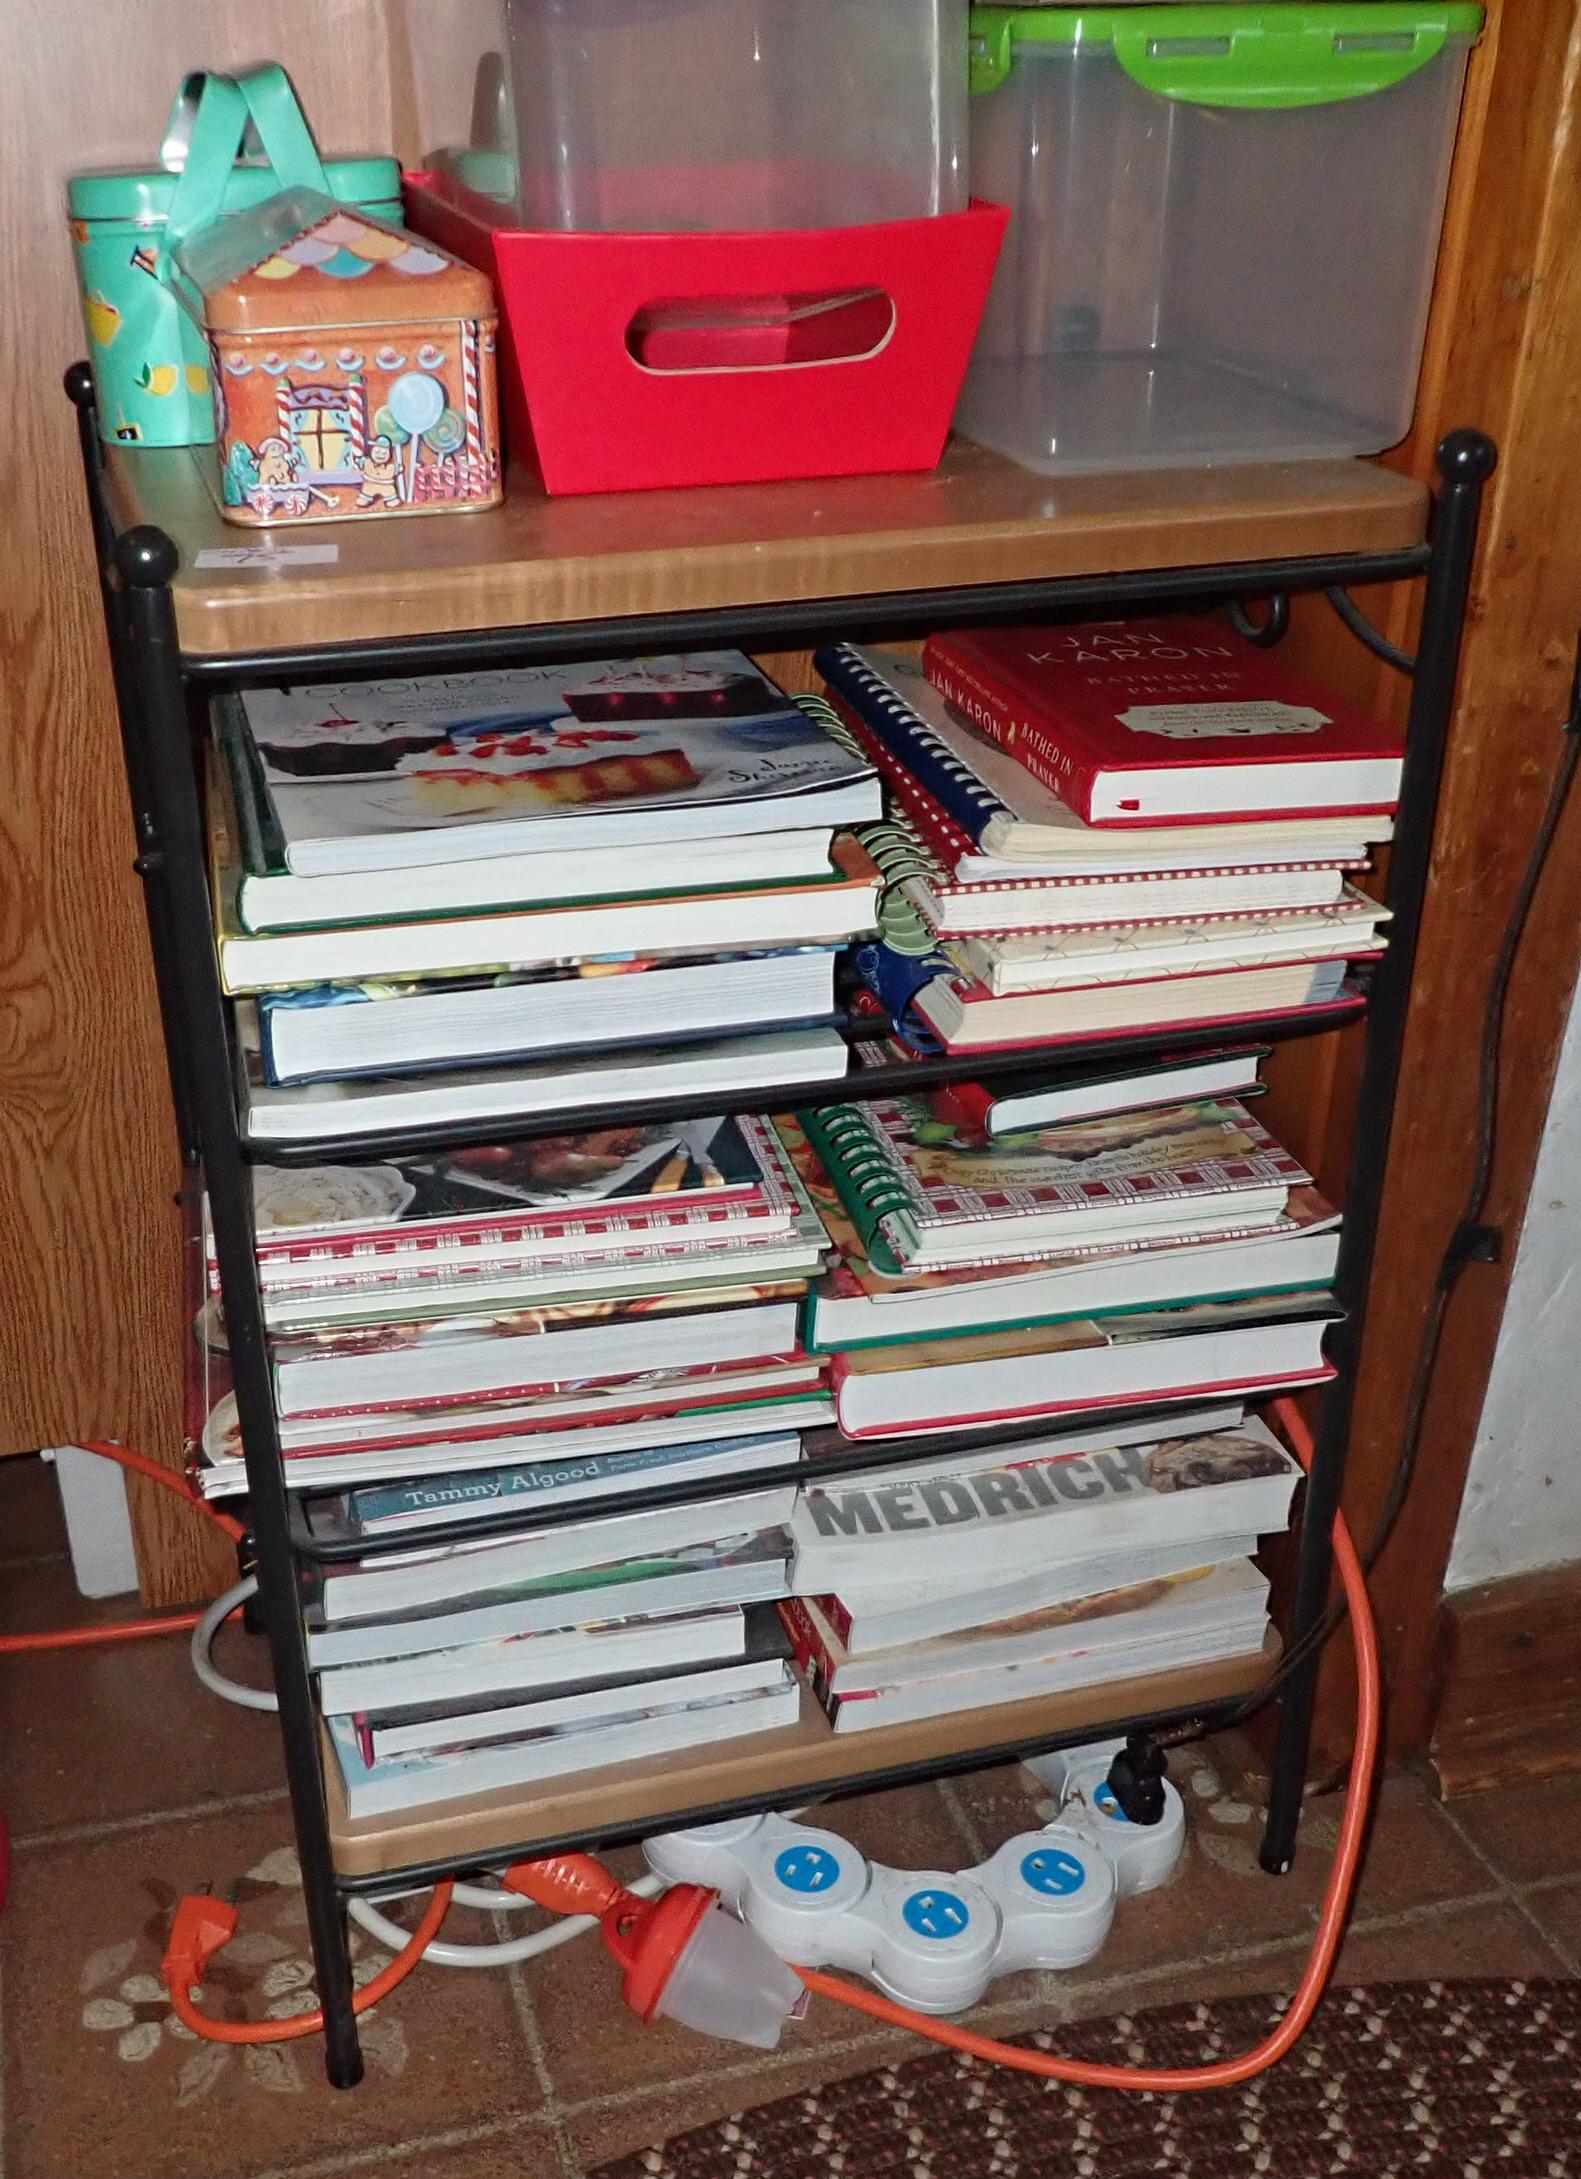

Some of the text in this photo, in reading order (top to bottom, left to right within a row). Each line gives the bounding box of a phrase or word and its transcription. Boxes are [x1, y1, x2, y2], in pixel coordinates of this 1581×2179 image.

[1027, 646, 1233, 664] KARON
[1060, 633, 1164, 647] JAN
[305, 671, 568, 698] COOKBOOK
[930, 669, 953, 699] JAN
[957, 688, 1001, 743] KARON
[1021, 722, 1074, 776] BATHED IN
[1027, 753, 1061, 793] PRAYER
[405, 1461, 600, 1506] Tammy Algood
[803, 1447, 1147, 1536] MEDRICH
